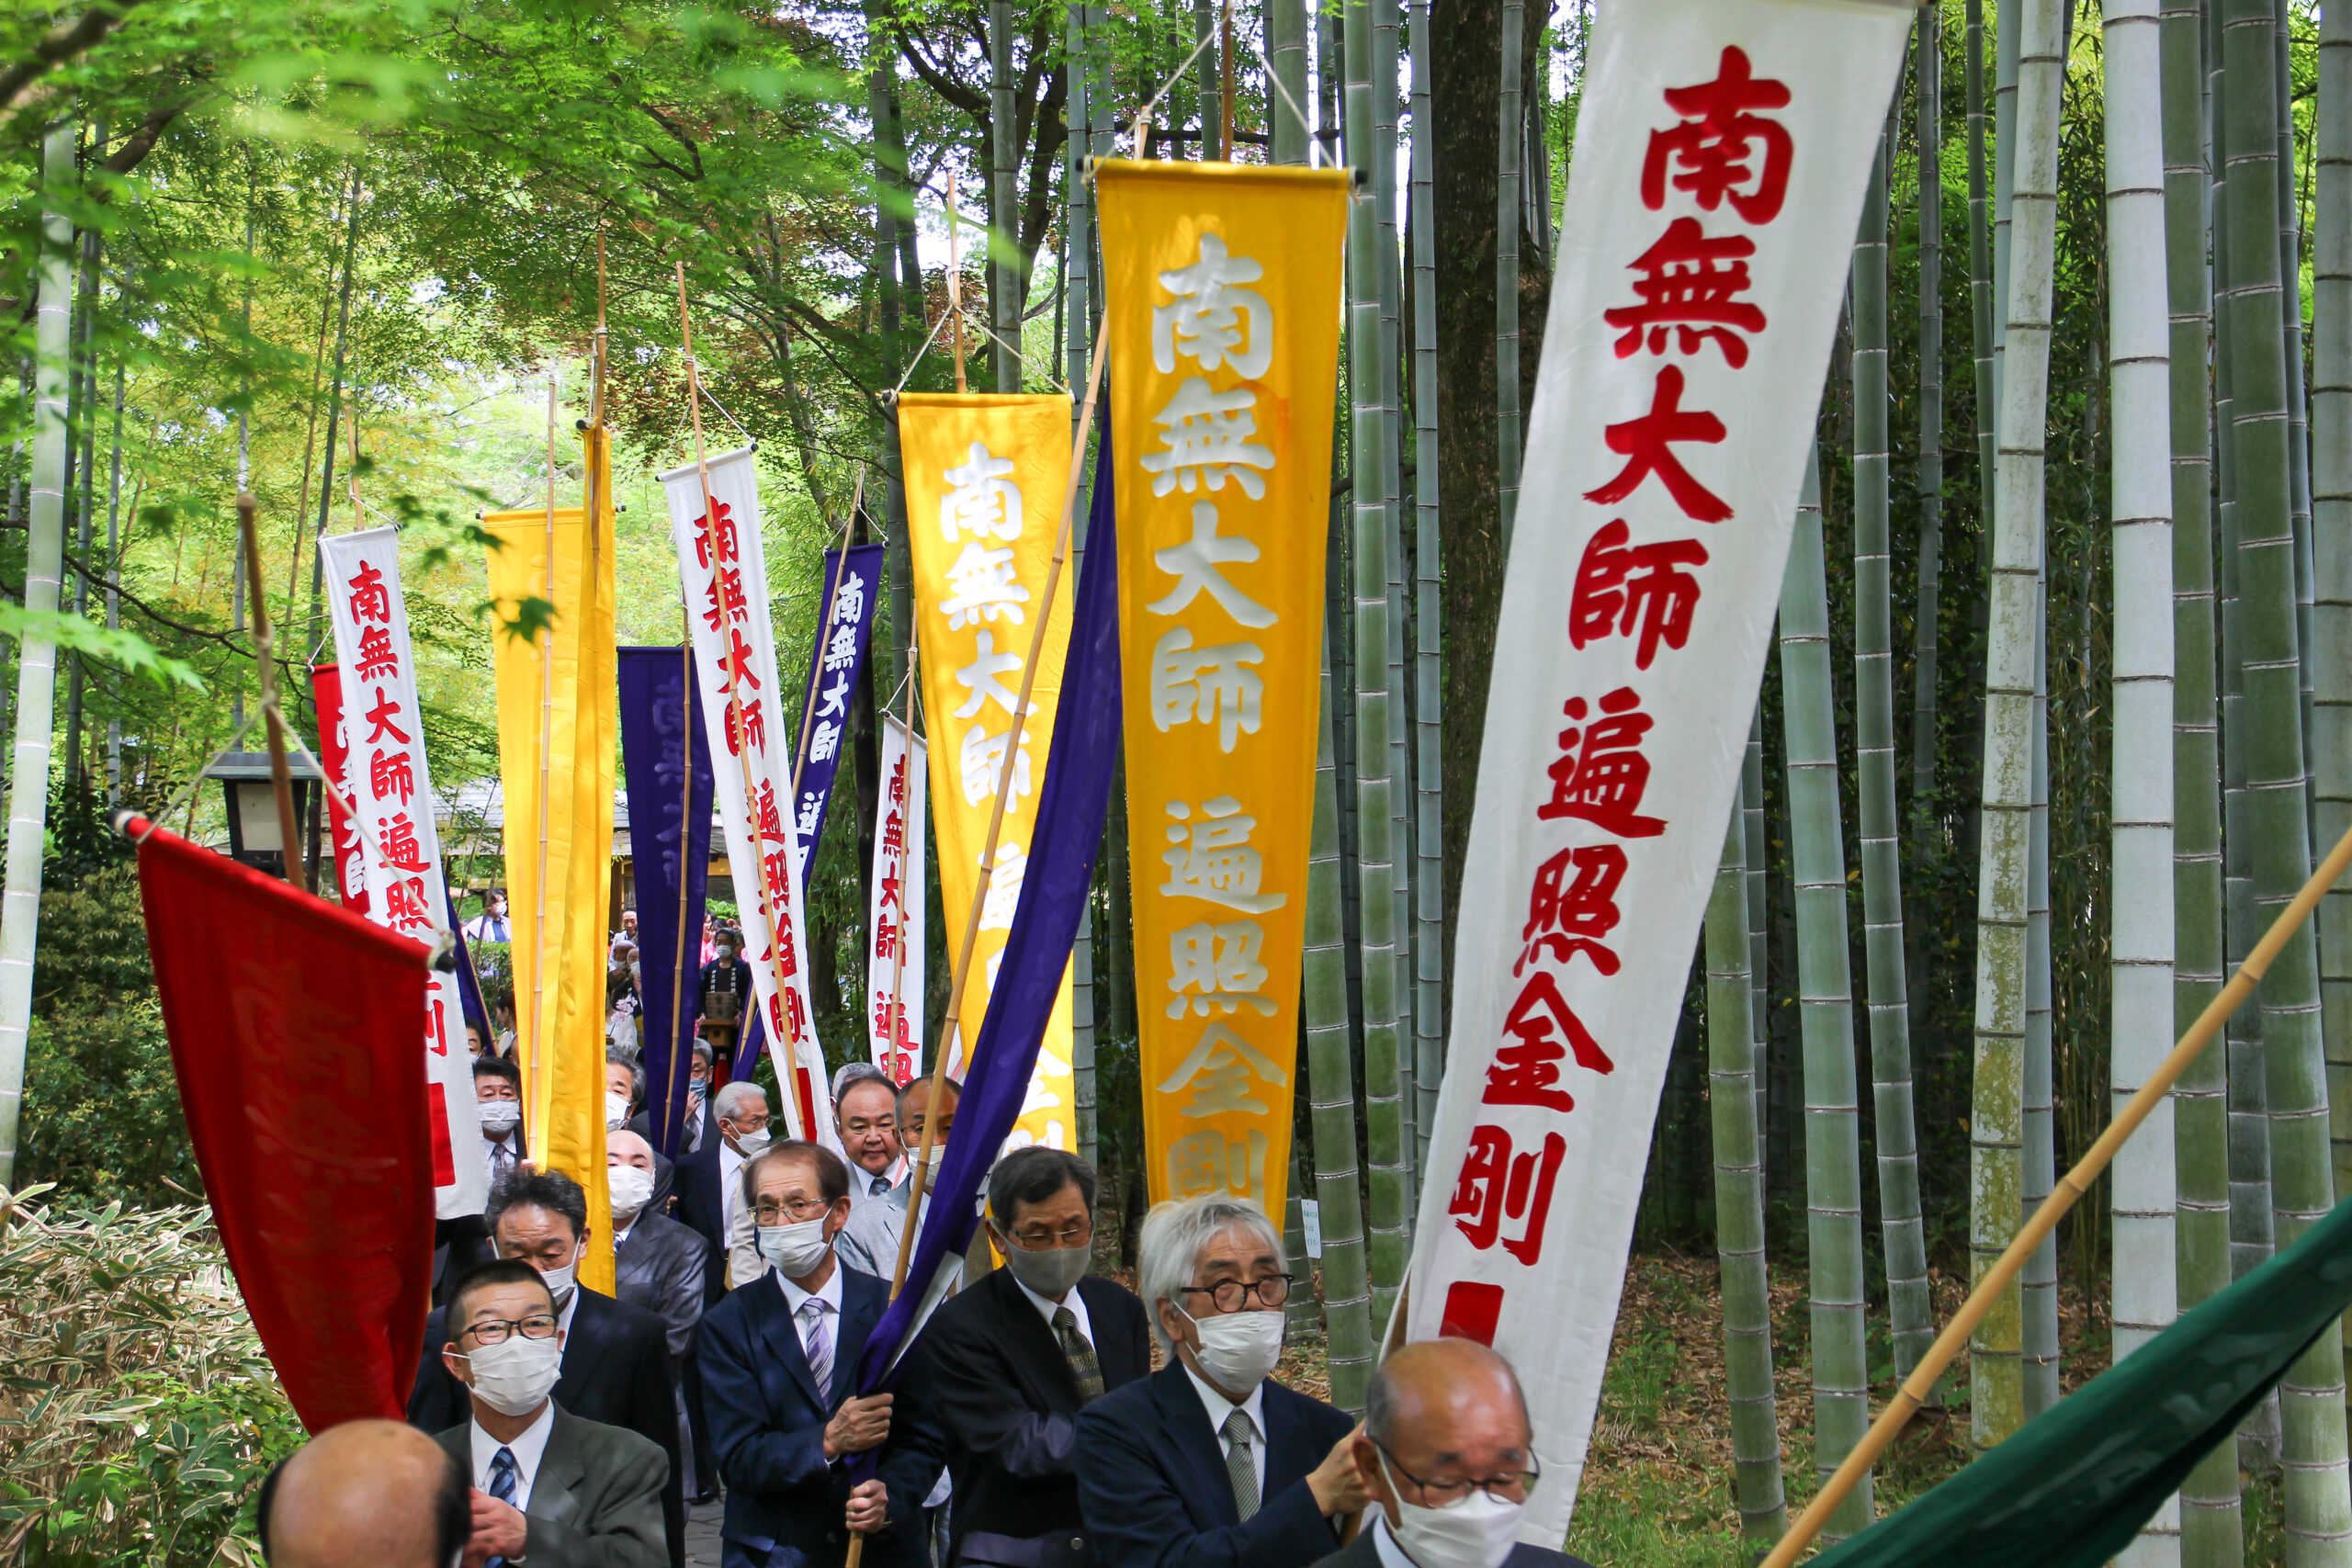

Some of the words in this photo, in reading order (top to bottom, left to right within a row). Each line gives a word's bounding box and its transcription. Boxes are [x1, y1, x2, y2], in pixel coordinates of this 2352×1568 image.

[1448, 44, 1793, 1266] 南無大師遍照金剛
